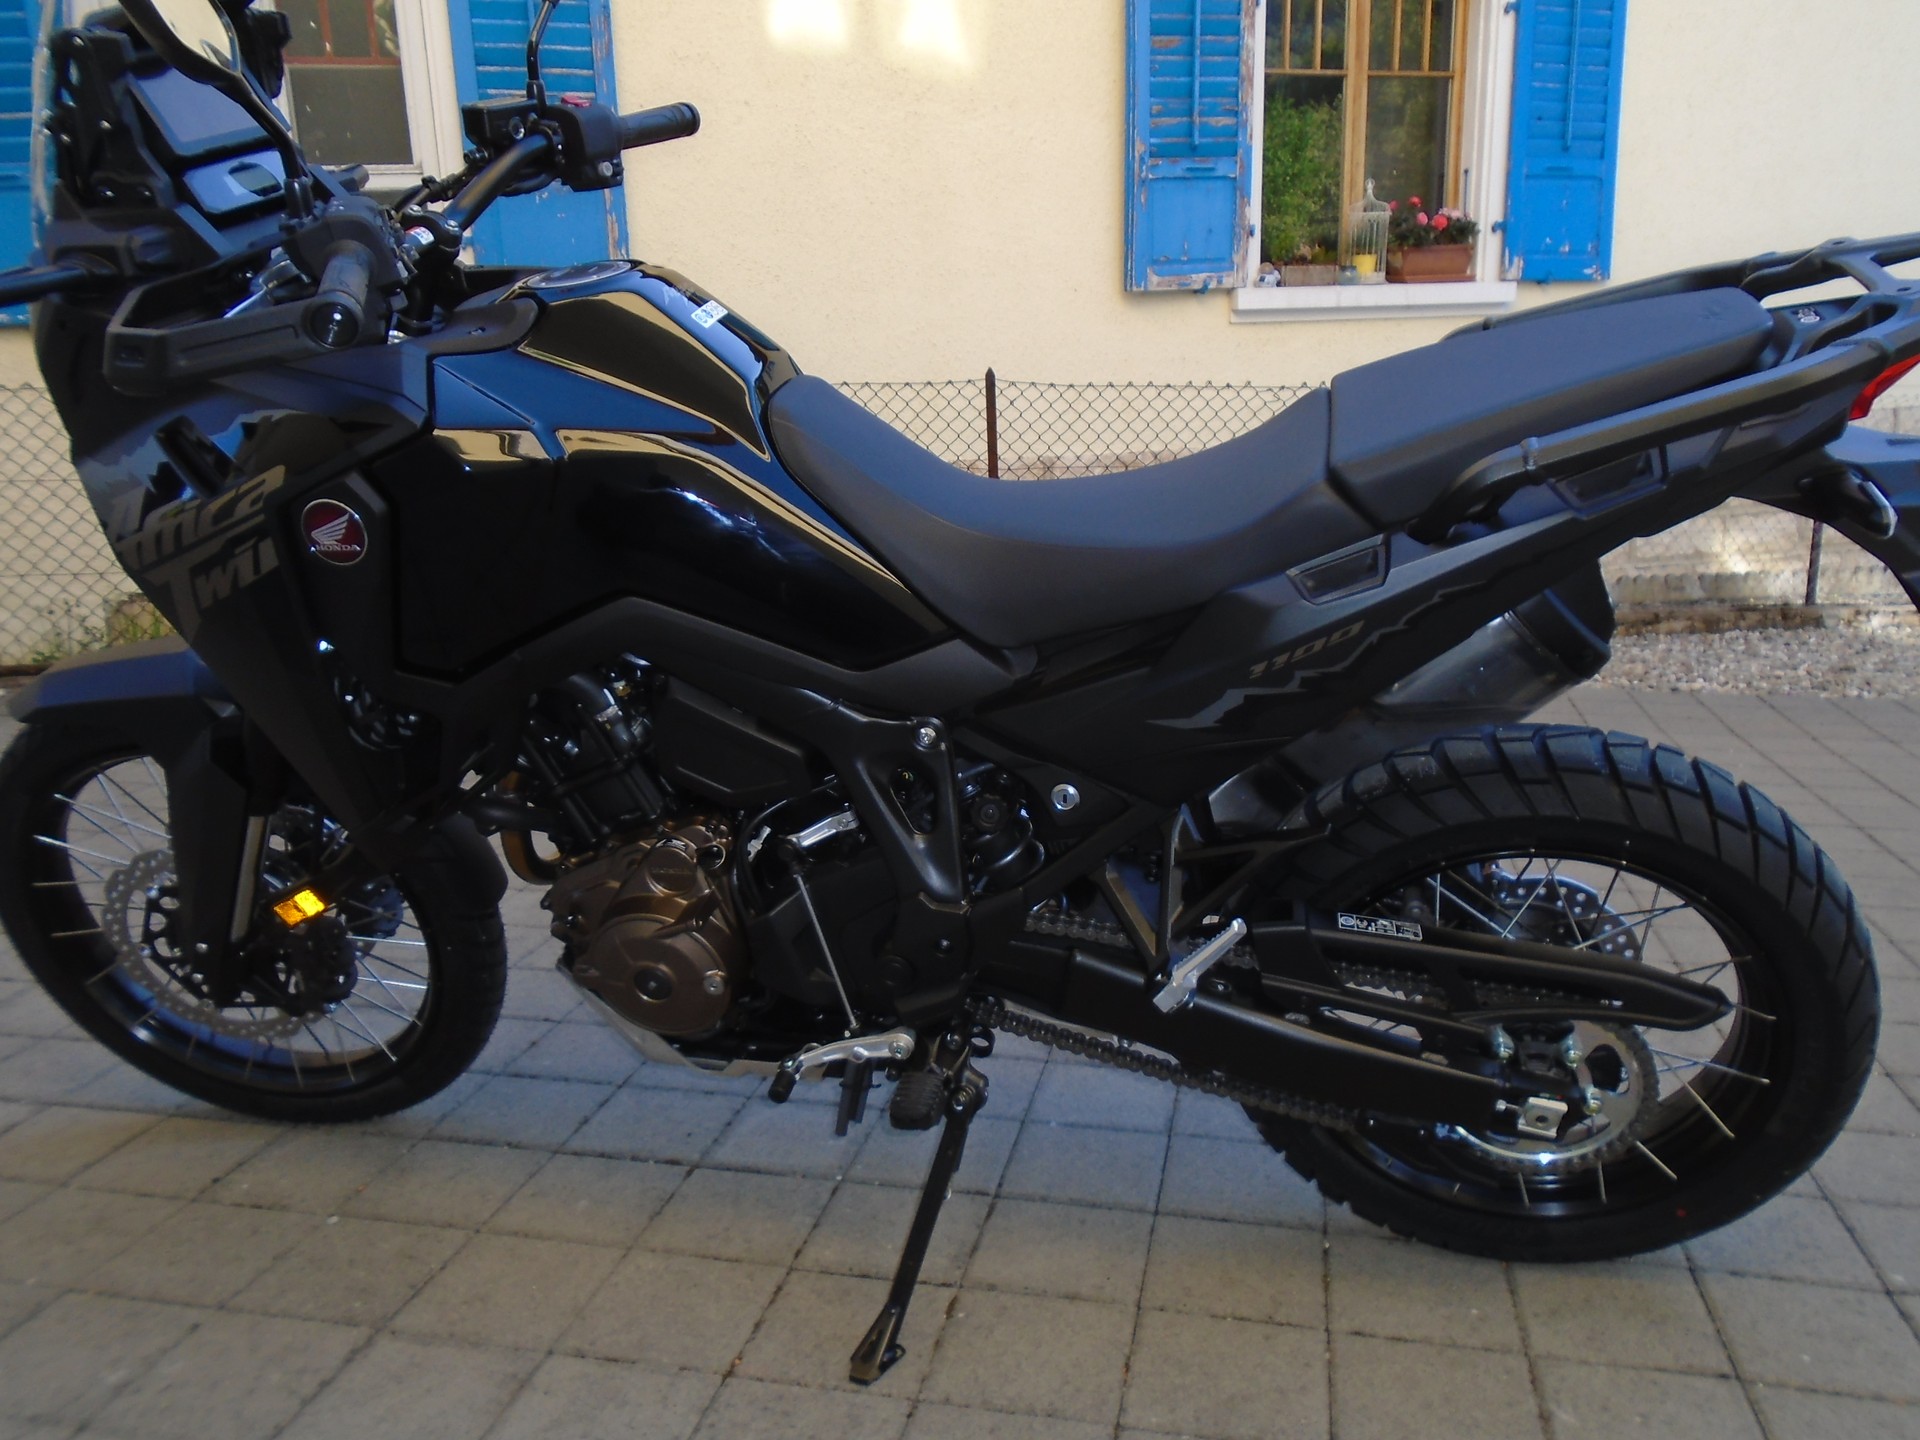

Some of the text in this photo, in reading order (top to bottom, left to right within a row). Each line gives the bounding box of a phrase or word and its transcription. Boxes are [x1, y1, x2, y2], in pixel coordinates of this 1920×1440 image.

[142, 514, 280, 639] Twin
[315, 544, 361, 552] HONDA
[1249, 621, 1365, 678] 1100
